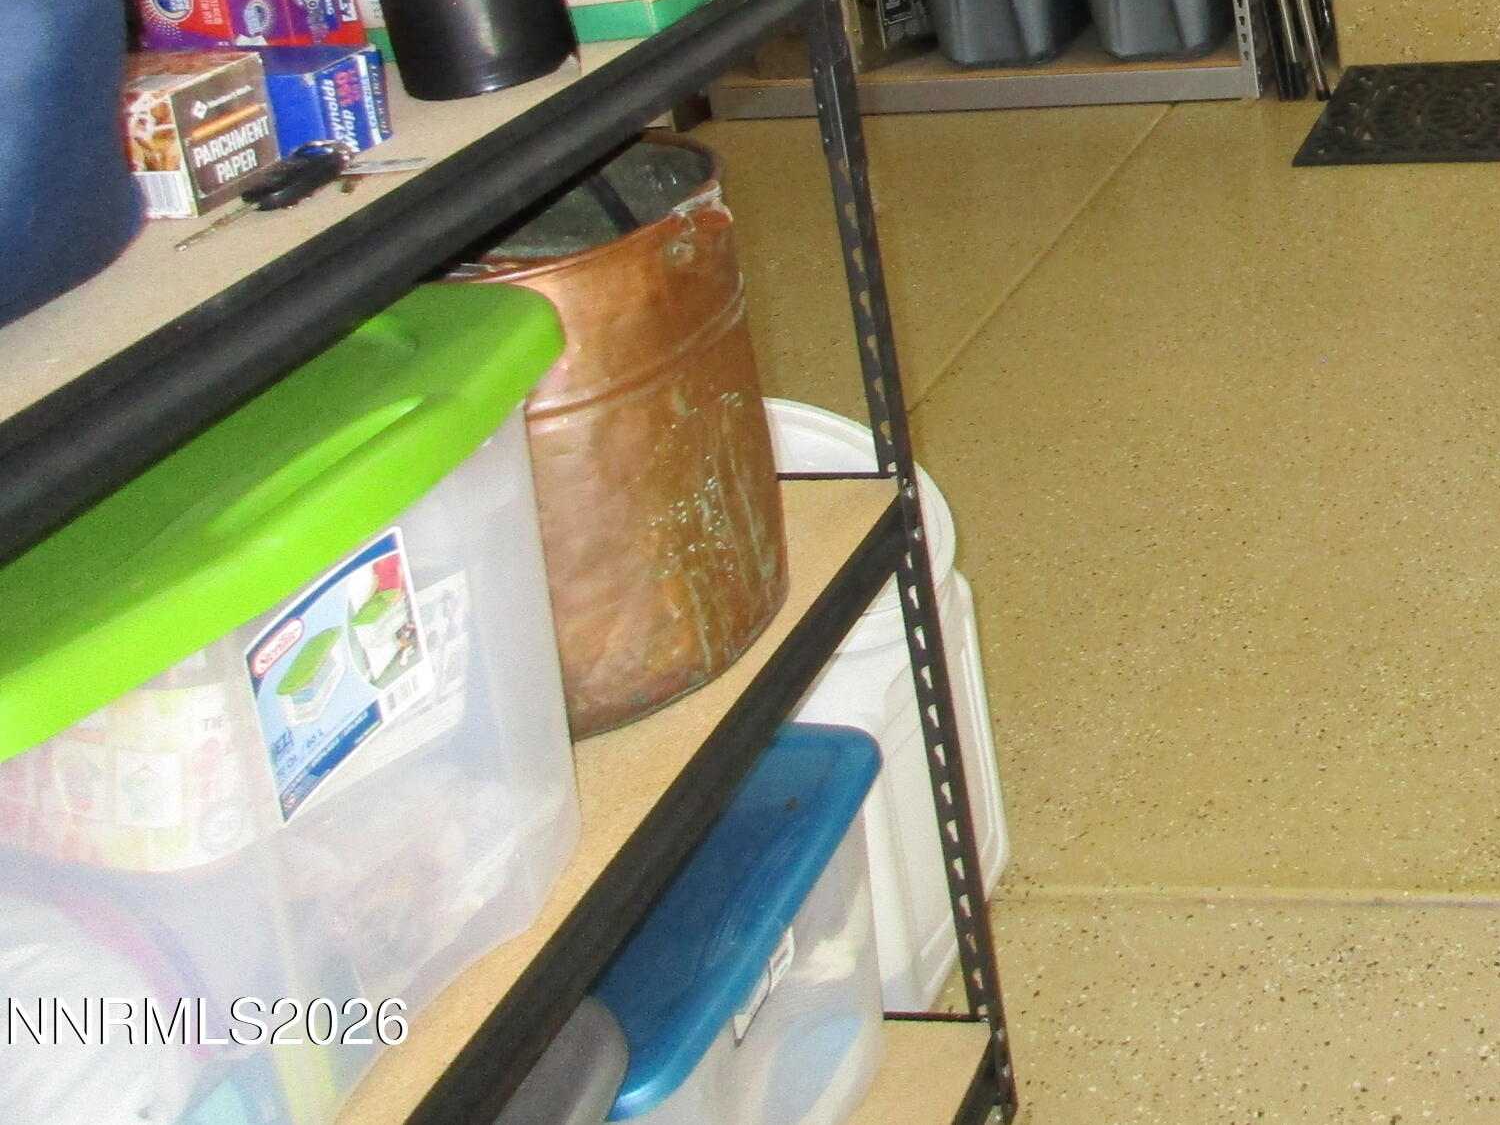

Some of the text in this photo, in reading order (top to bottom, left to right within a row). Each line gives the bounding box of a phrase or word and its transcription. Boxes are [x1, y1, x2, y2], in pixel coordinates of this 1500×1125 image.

[321, 78, 345, 141] eynolds
[192, 115, 270, 168] PARCHMENT
[215, 148, 258, 184] PAPER
